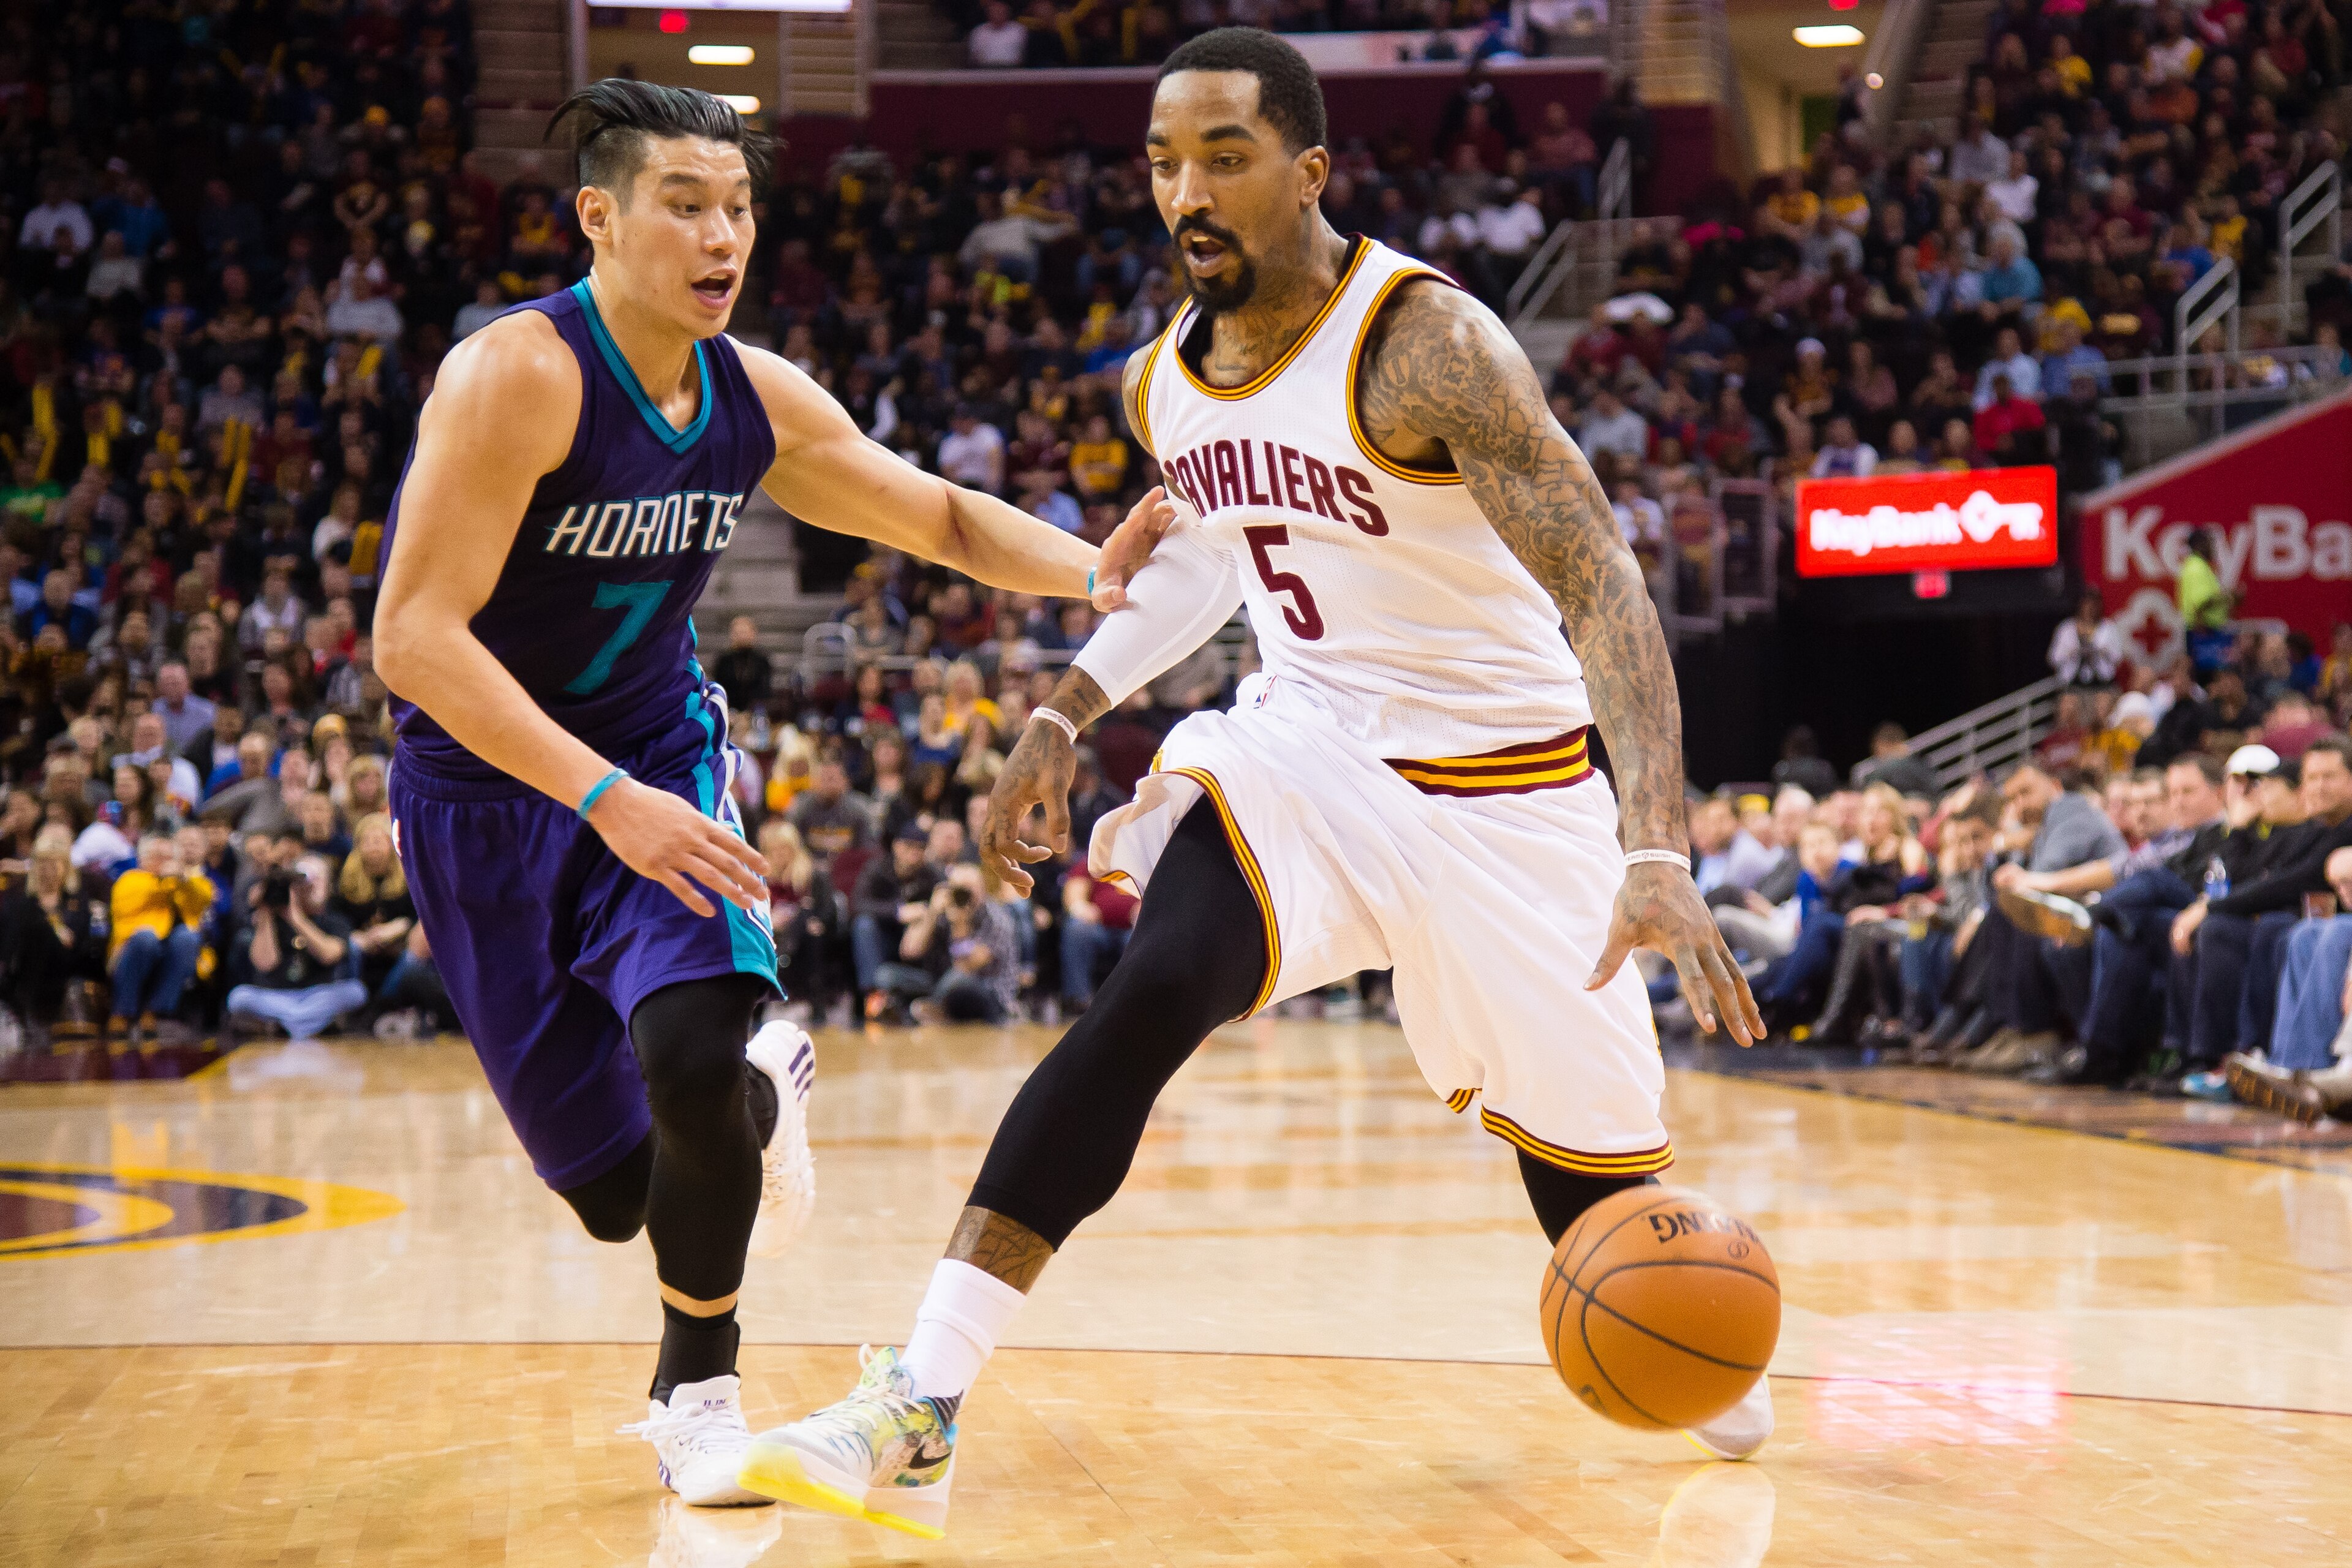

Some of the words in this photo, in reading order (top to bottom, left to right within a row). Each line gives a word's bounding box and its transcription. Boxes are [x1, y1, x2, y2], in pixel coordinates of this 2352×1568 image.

[544, 490, 745, 559] HORNETS
[1243, 524, 1324, 641] 5
[562, 579, 675, 695] 7
